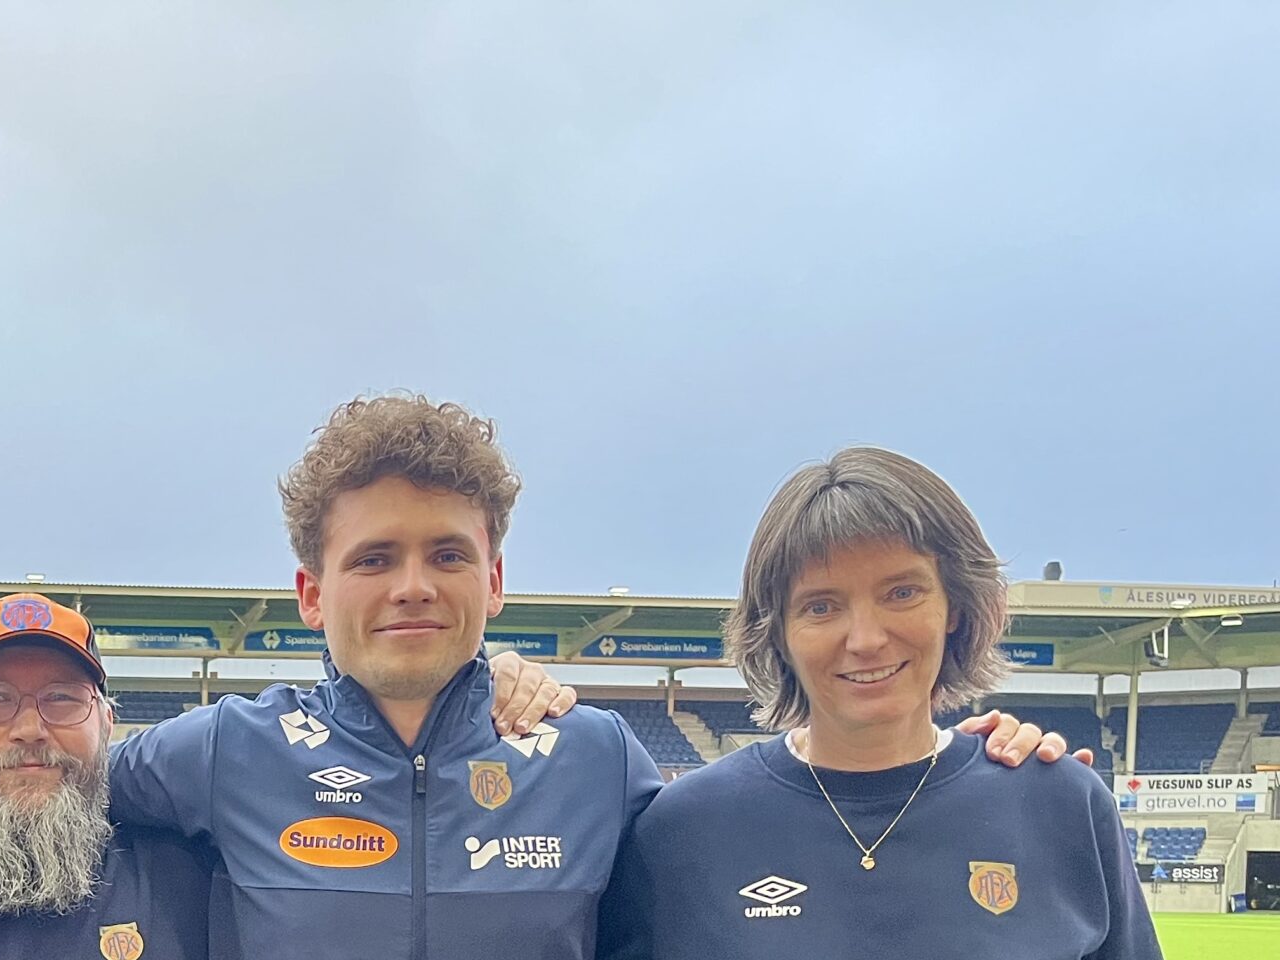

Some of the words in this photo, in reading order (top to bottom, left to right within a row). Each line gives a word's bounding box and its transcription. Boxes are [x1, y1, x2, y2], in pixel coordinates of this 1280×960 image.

[1203, 592, 1280, 605] VIDEREGÅ
[621, 642, 681, 653] Sparebanken
[683, 643, 708, 653] Møre
[1148, 778, 1202, 789] VEGSUND
[1207, 778, 1233, 789] SLIP
[1236, 778, 1253, 789] AS
[315, 790, 362, 803] umbro
[1146, 794, 1227, 811] gtravel.no
[288, 831, 385, 852] Sundolitt
[503, 836, 562, 852] INTER
[505, 852, 562, 869] SPORT
[1172, 866, 1219, 879] assist
[744, 904, 802, 918] umbro
